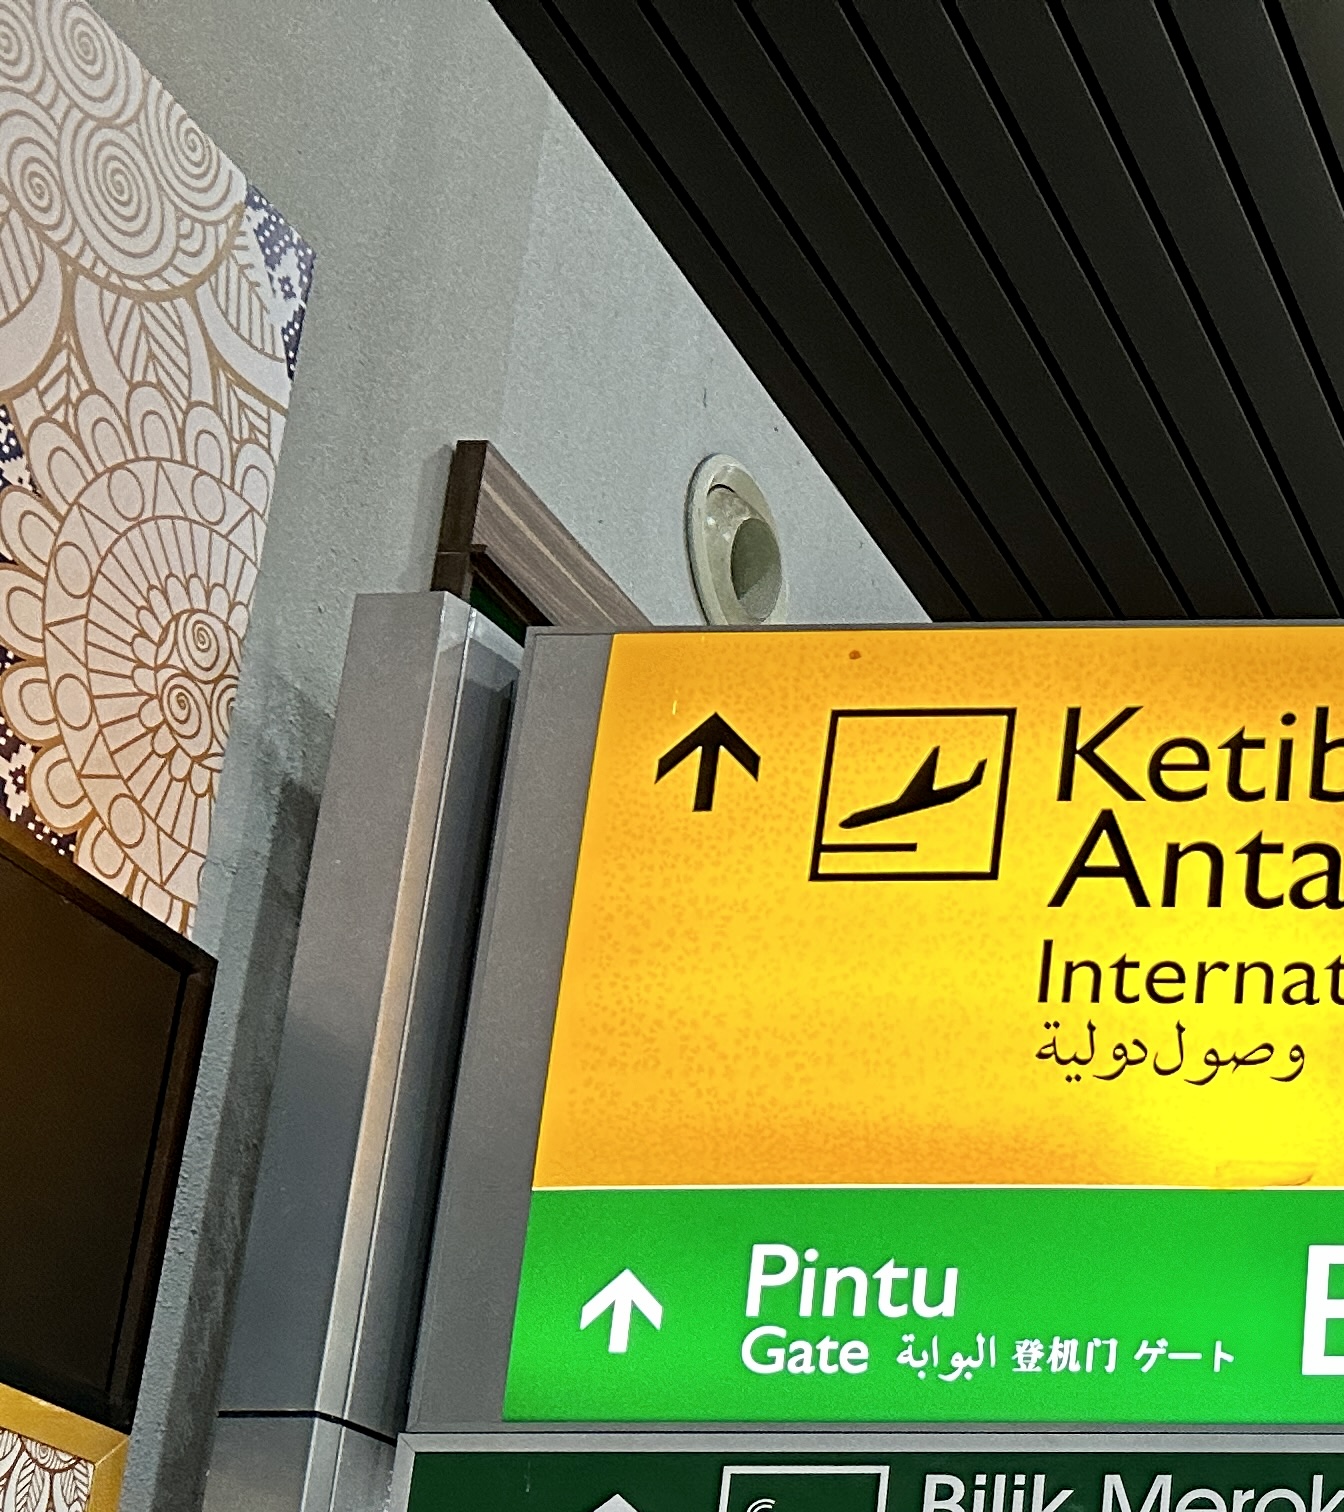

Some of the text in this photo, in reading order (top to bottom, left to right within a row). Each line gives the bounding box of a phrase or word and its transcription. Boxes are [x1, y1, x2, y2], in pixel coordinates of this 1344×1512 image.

[745, 1243, 960, 1318] Pintu
[741, 1325, 870, 1374] Gate
[895, 1332, 997, 1382] البوابة
[1011, 1337, 1118, 1373] 登机门
[1132, 1337, 1236, 1373] ゲート
